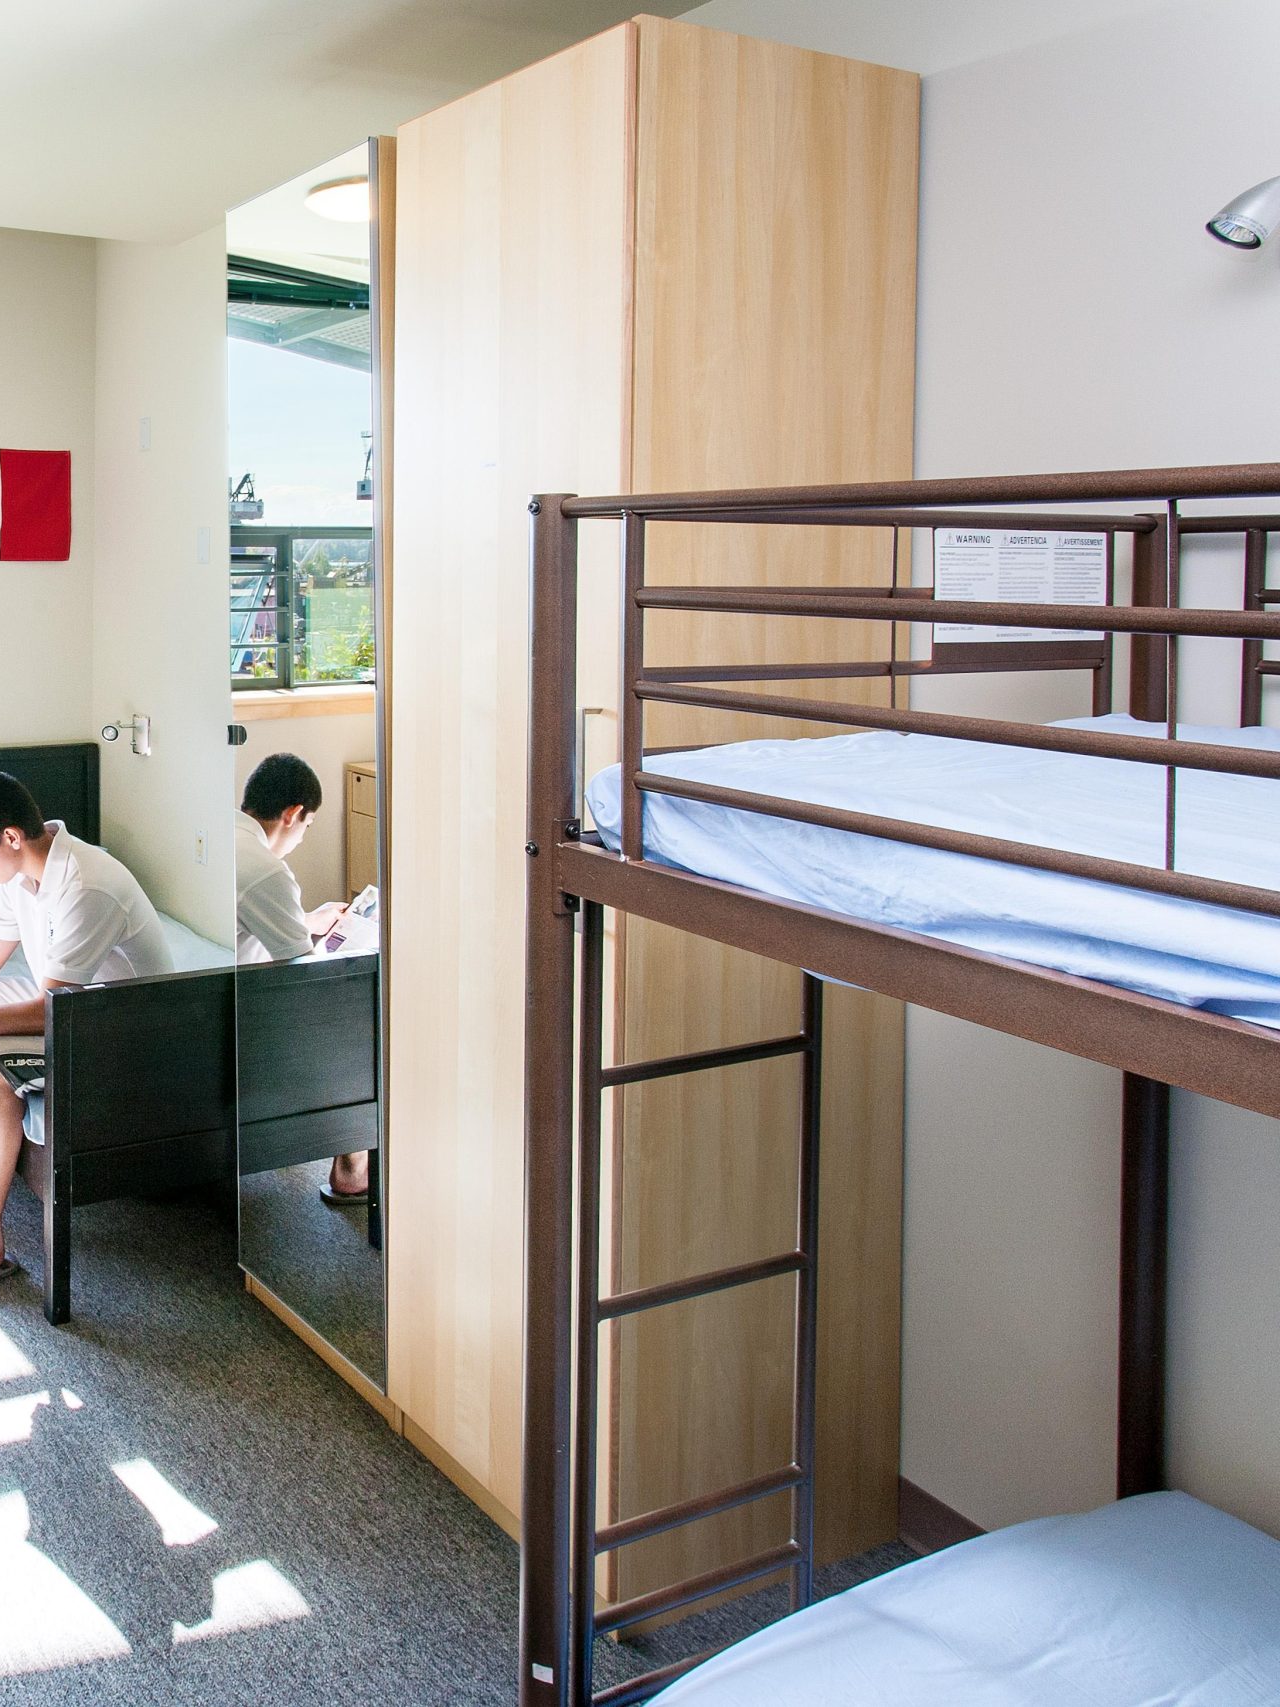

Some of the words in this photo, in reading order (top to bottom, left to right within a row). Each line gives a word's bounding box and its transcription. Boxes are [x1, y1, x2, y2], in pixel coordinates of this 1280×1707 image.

[955, 534, 991, 544] WARNING
[1009, 536, 1048, 545] ADVERTENCIA
[1063, 538, 1103, 546] AVERTISSEMENT
